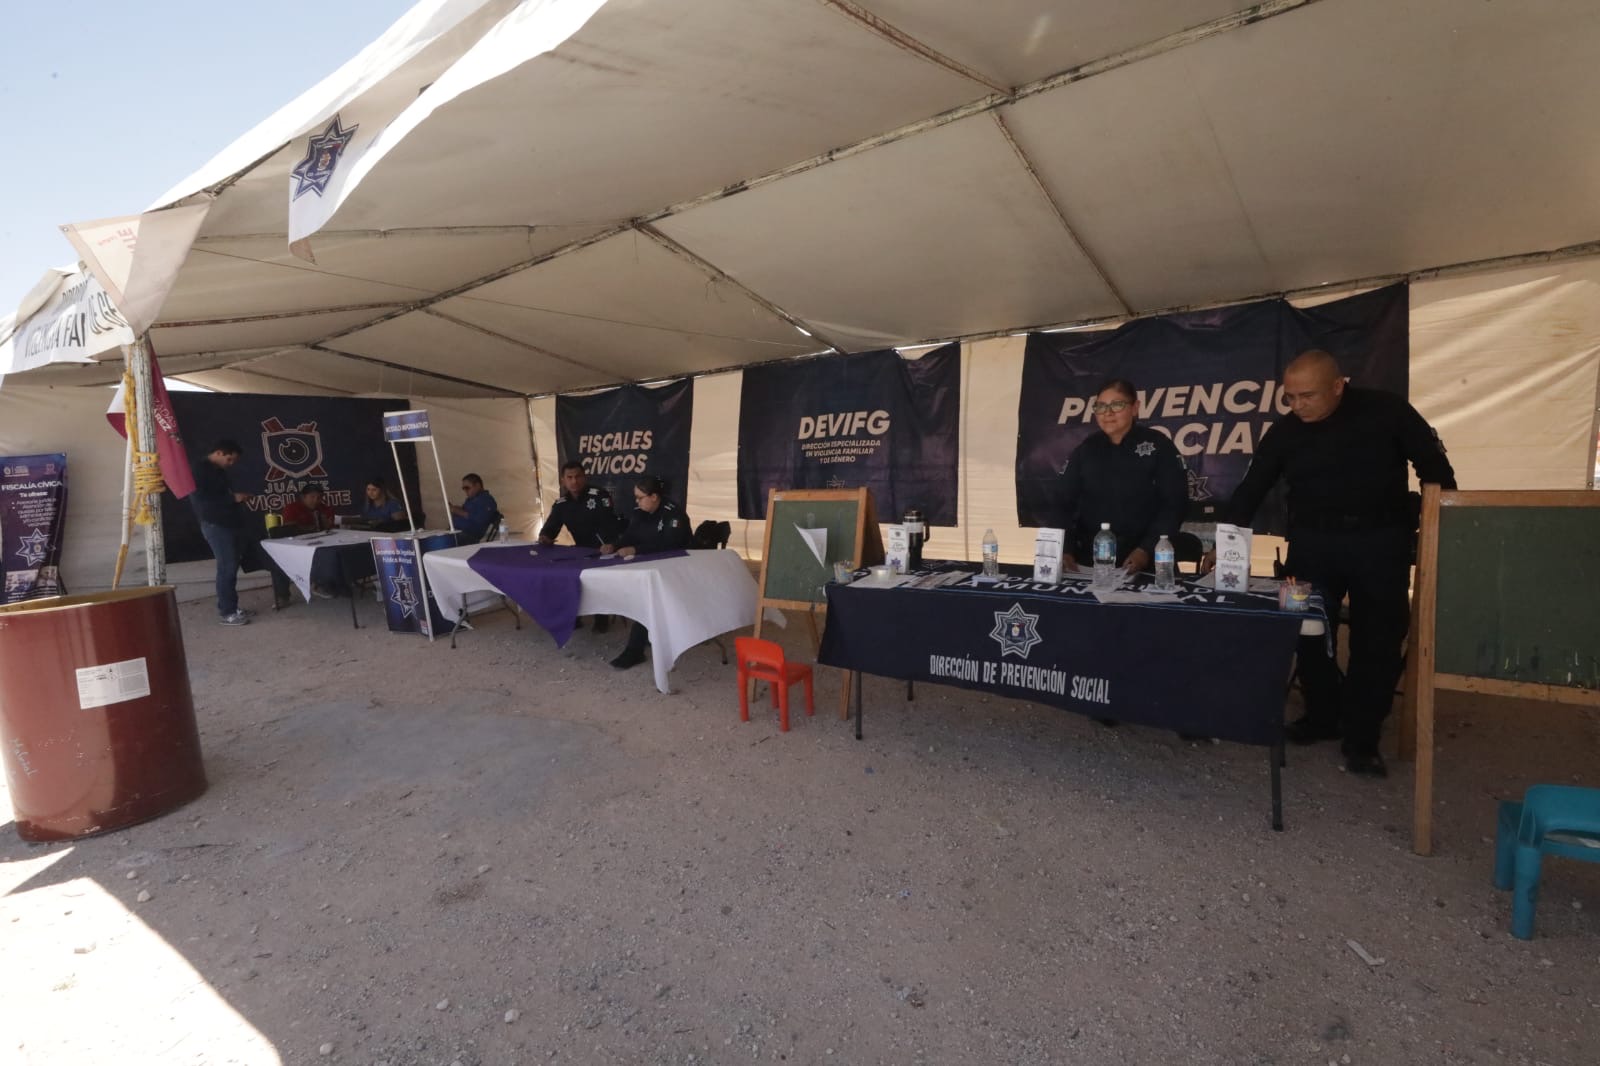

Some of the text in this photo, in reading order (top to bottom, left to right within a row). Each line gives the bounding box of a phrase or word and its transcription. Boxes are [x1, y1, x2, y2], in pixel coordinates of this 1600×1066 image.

[798, 410, 890, 440] DEVIFG
[579, 430, 653, 453] FISCALES
[831, 439, 880, 448] ESPECIALIZADA
[814, 448, 841, 457] VIOLENCIA
[842, 447, 874, 455] FAMILIAR
[831, 455, 856, 463] GÉNERO
[581, 452, 648, 475] CÍVICOS
[1, 481, 37, 491] FISCALÍA
[929, 653, 1110, 704] DIRECCIÓN DE PREVENCIÓN SOCIAL
